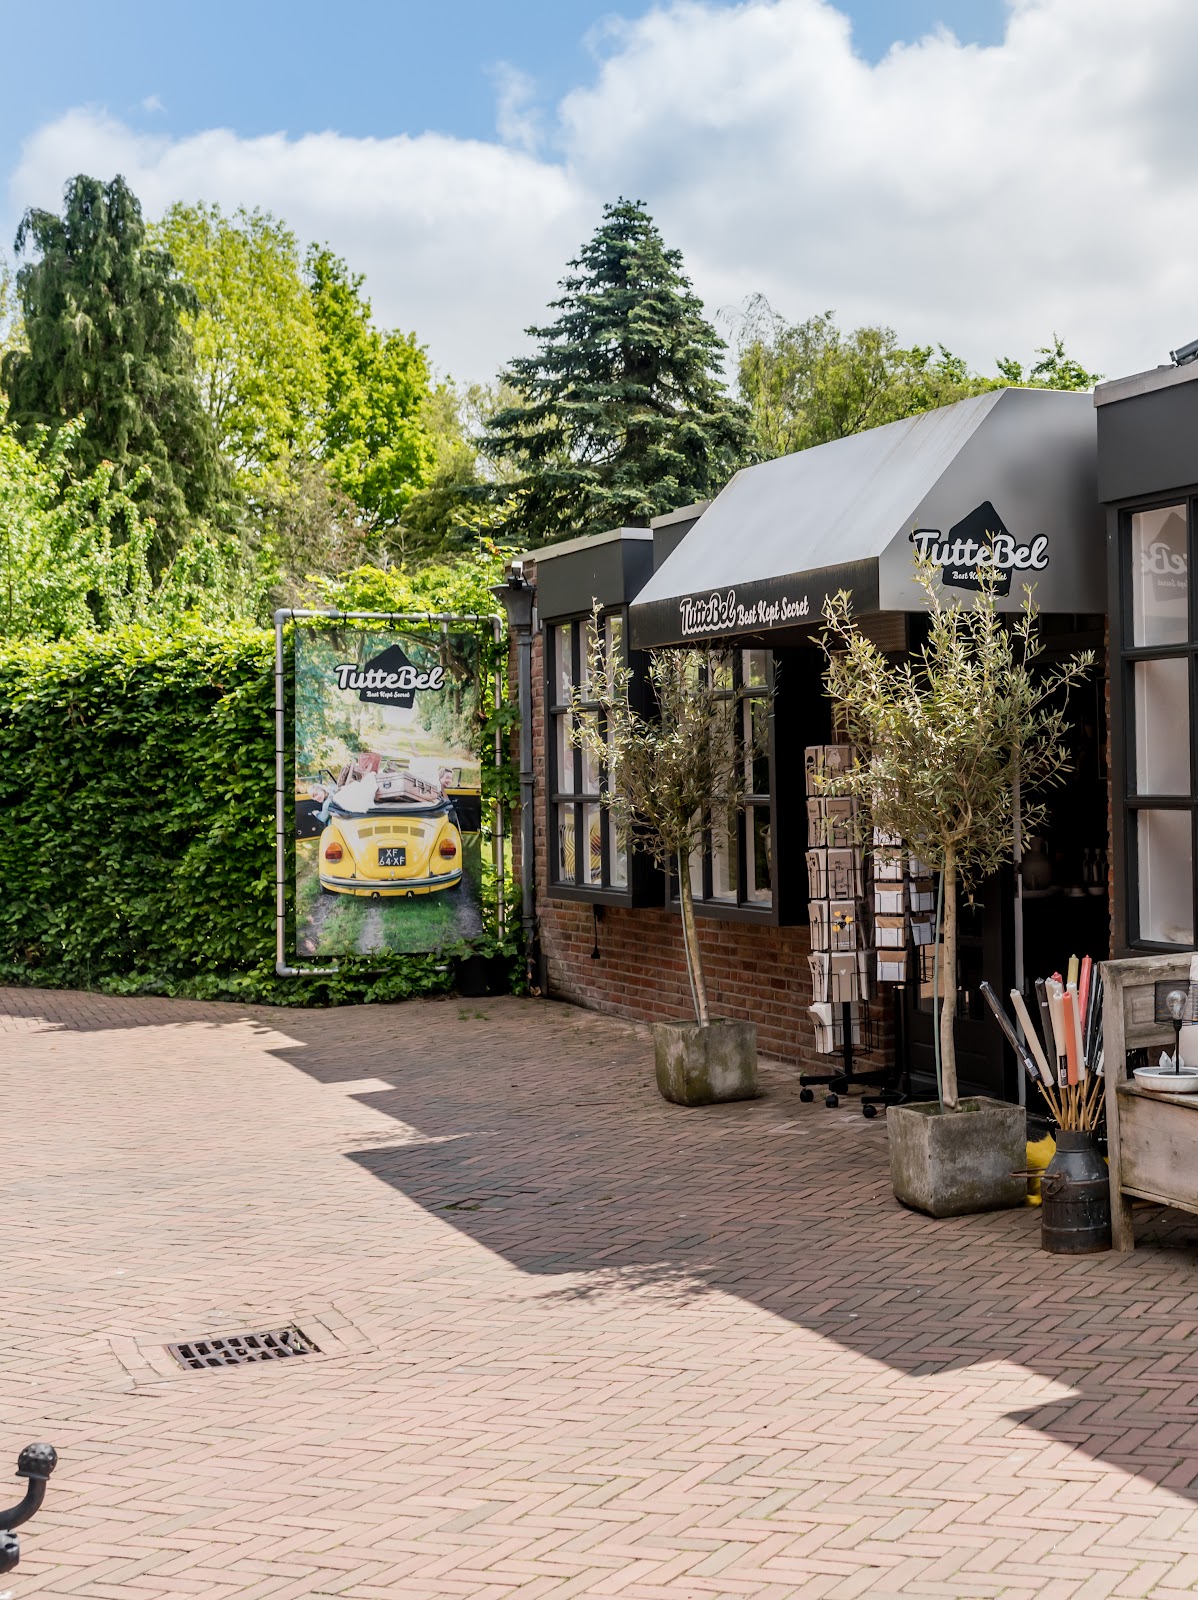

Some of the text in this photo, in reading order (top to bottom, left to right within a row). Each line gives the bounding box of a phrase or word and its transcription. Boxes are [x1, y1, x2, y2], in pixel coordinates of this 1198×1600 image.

[912, 531, 1049, 569] TutteBel
[952, 571, 969, 580] Best
[680, 590, 810, 635] TutteBel Best Kept Secret
[335, 664, 445, 690] TutteBel
[386, 849, 399, 857] XF
